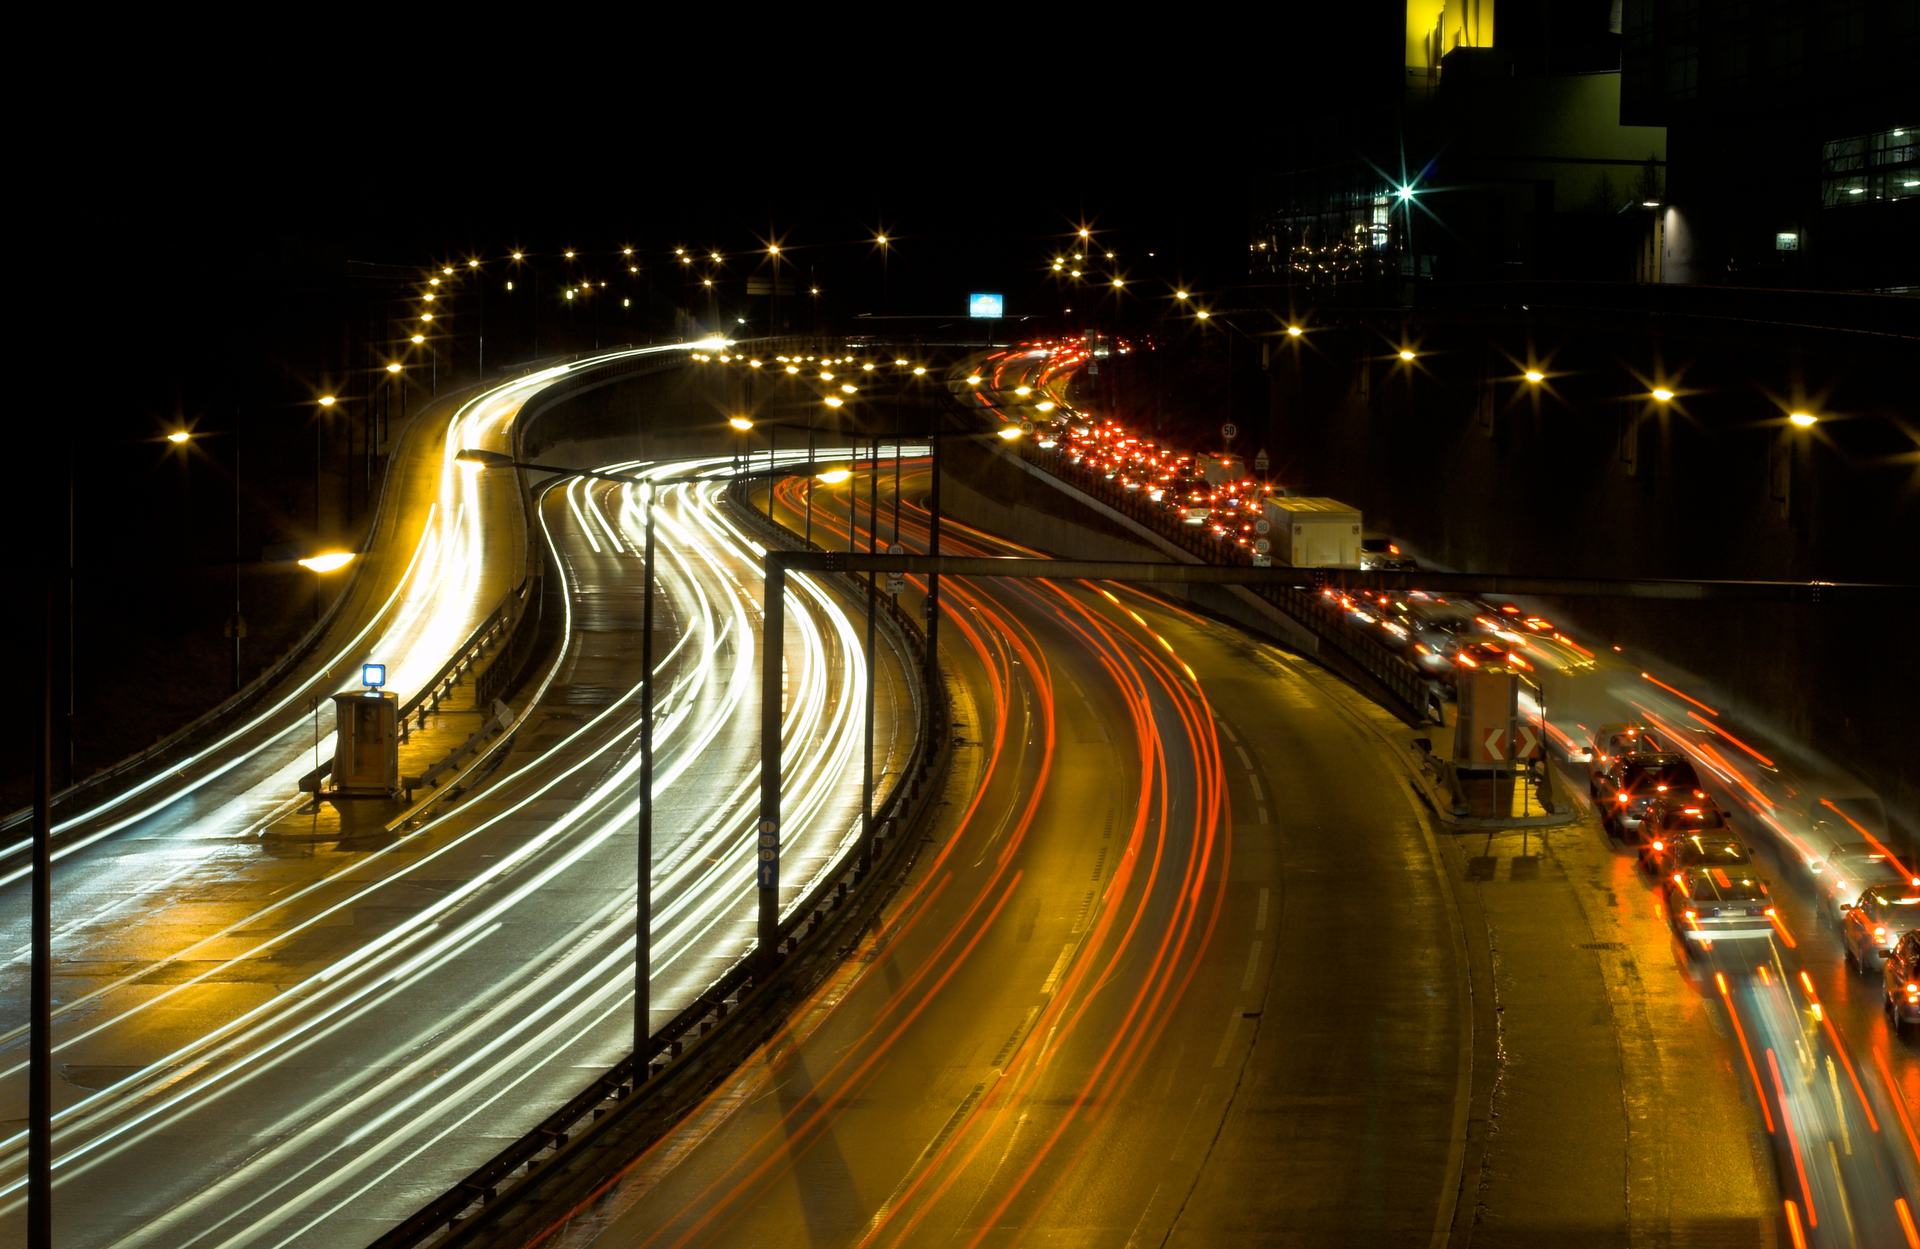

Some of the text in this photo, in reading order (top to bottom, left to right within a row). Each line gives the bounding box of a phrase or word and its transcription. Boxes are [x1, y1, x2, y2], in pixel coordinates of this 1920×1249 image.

[1224, 425, 1235, 436] 50
[1257, 522, 1268, 532] 80
[1257, 541, 1268, 551] 60
[761, 836, 774, 846] SLO
[764, 850, 771, 860] D
